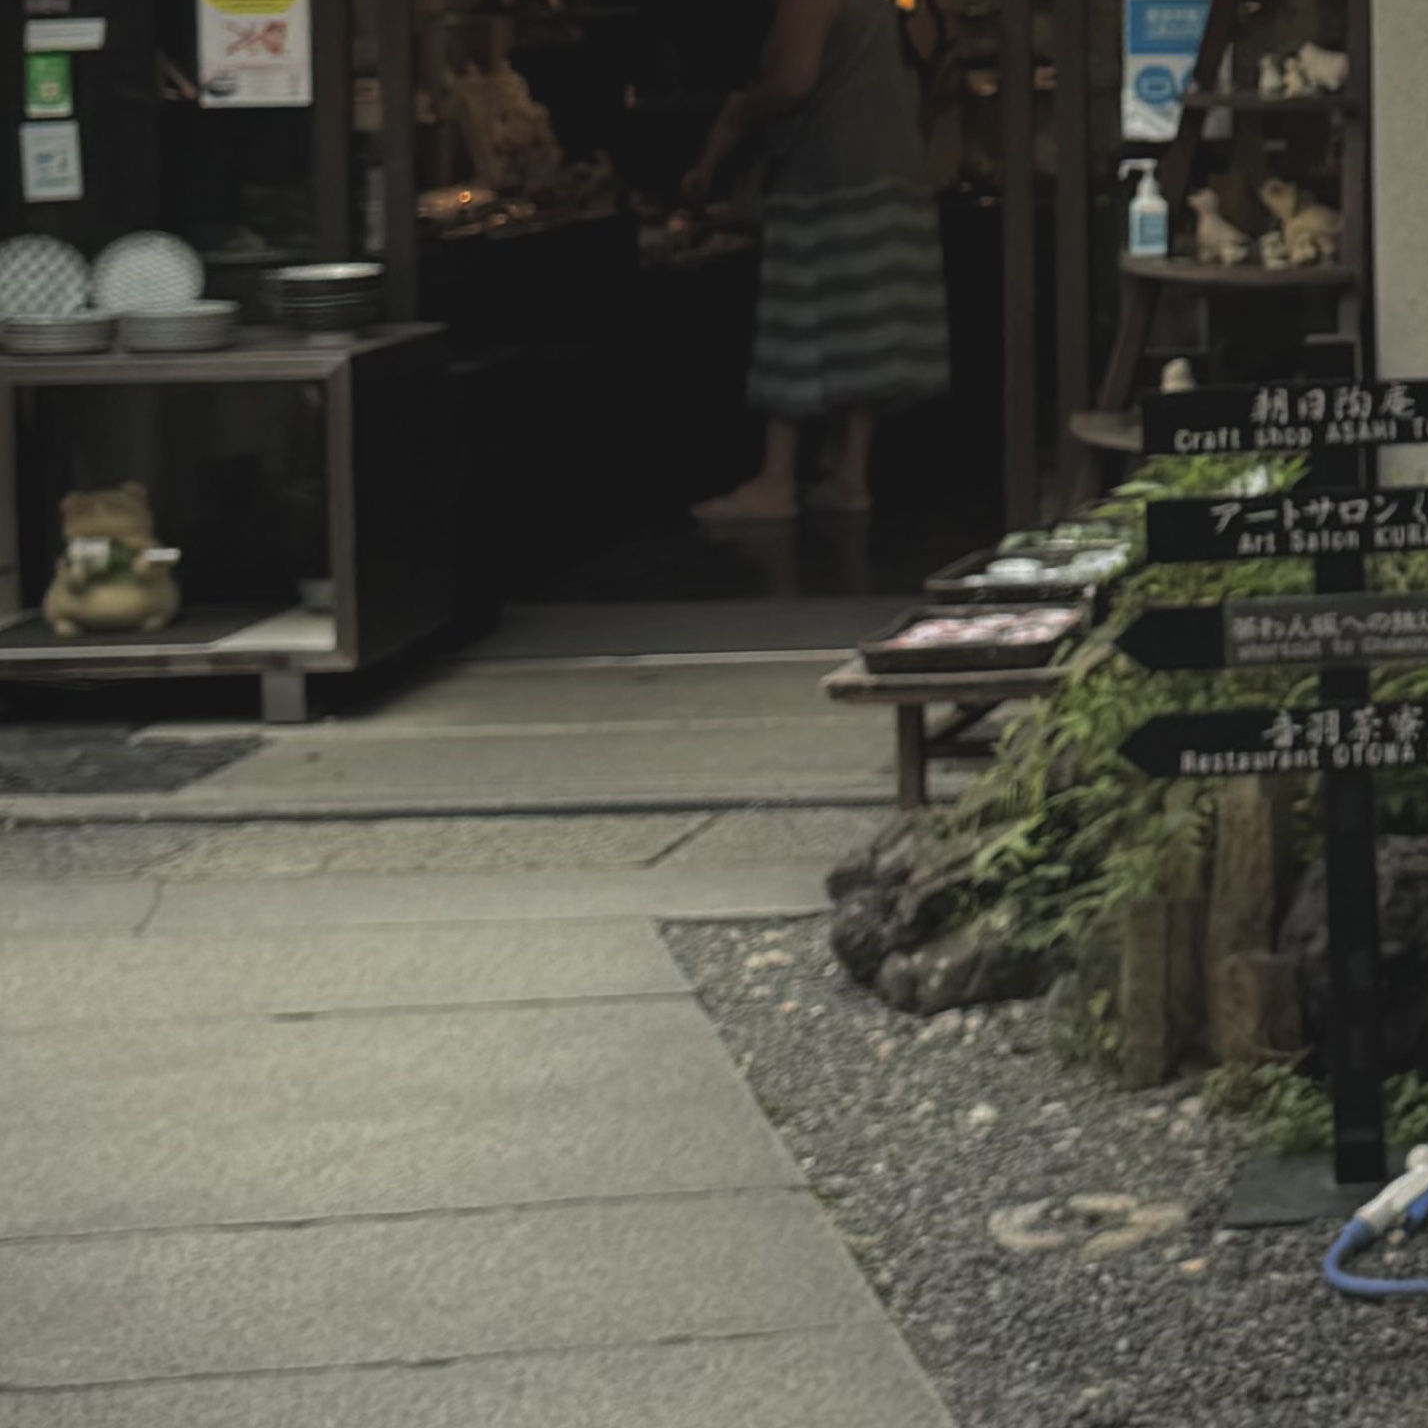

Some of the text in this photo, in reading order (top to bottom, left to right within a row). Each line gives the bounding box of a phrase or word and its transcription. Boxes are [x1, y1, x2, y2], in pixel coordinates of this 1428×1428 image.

[1173, 426, 1240, 452] Craft
[1324, 419, 1398, 445] ASAHI
[1237, 531, 1276, 556] Art
[1287, 529, 1361, 553] Salon
[1179, 745, 1319, 774] Restaurant
